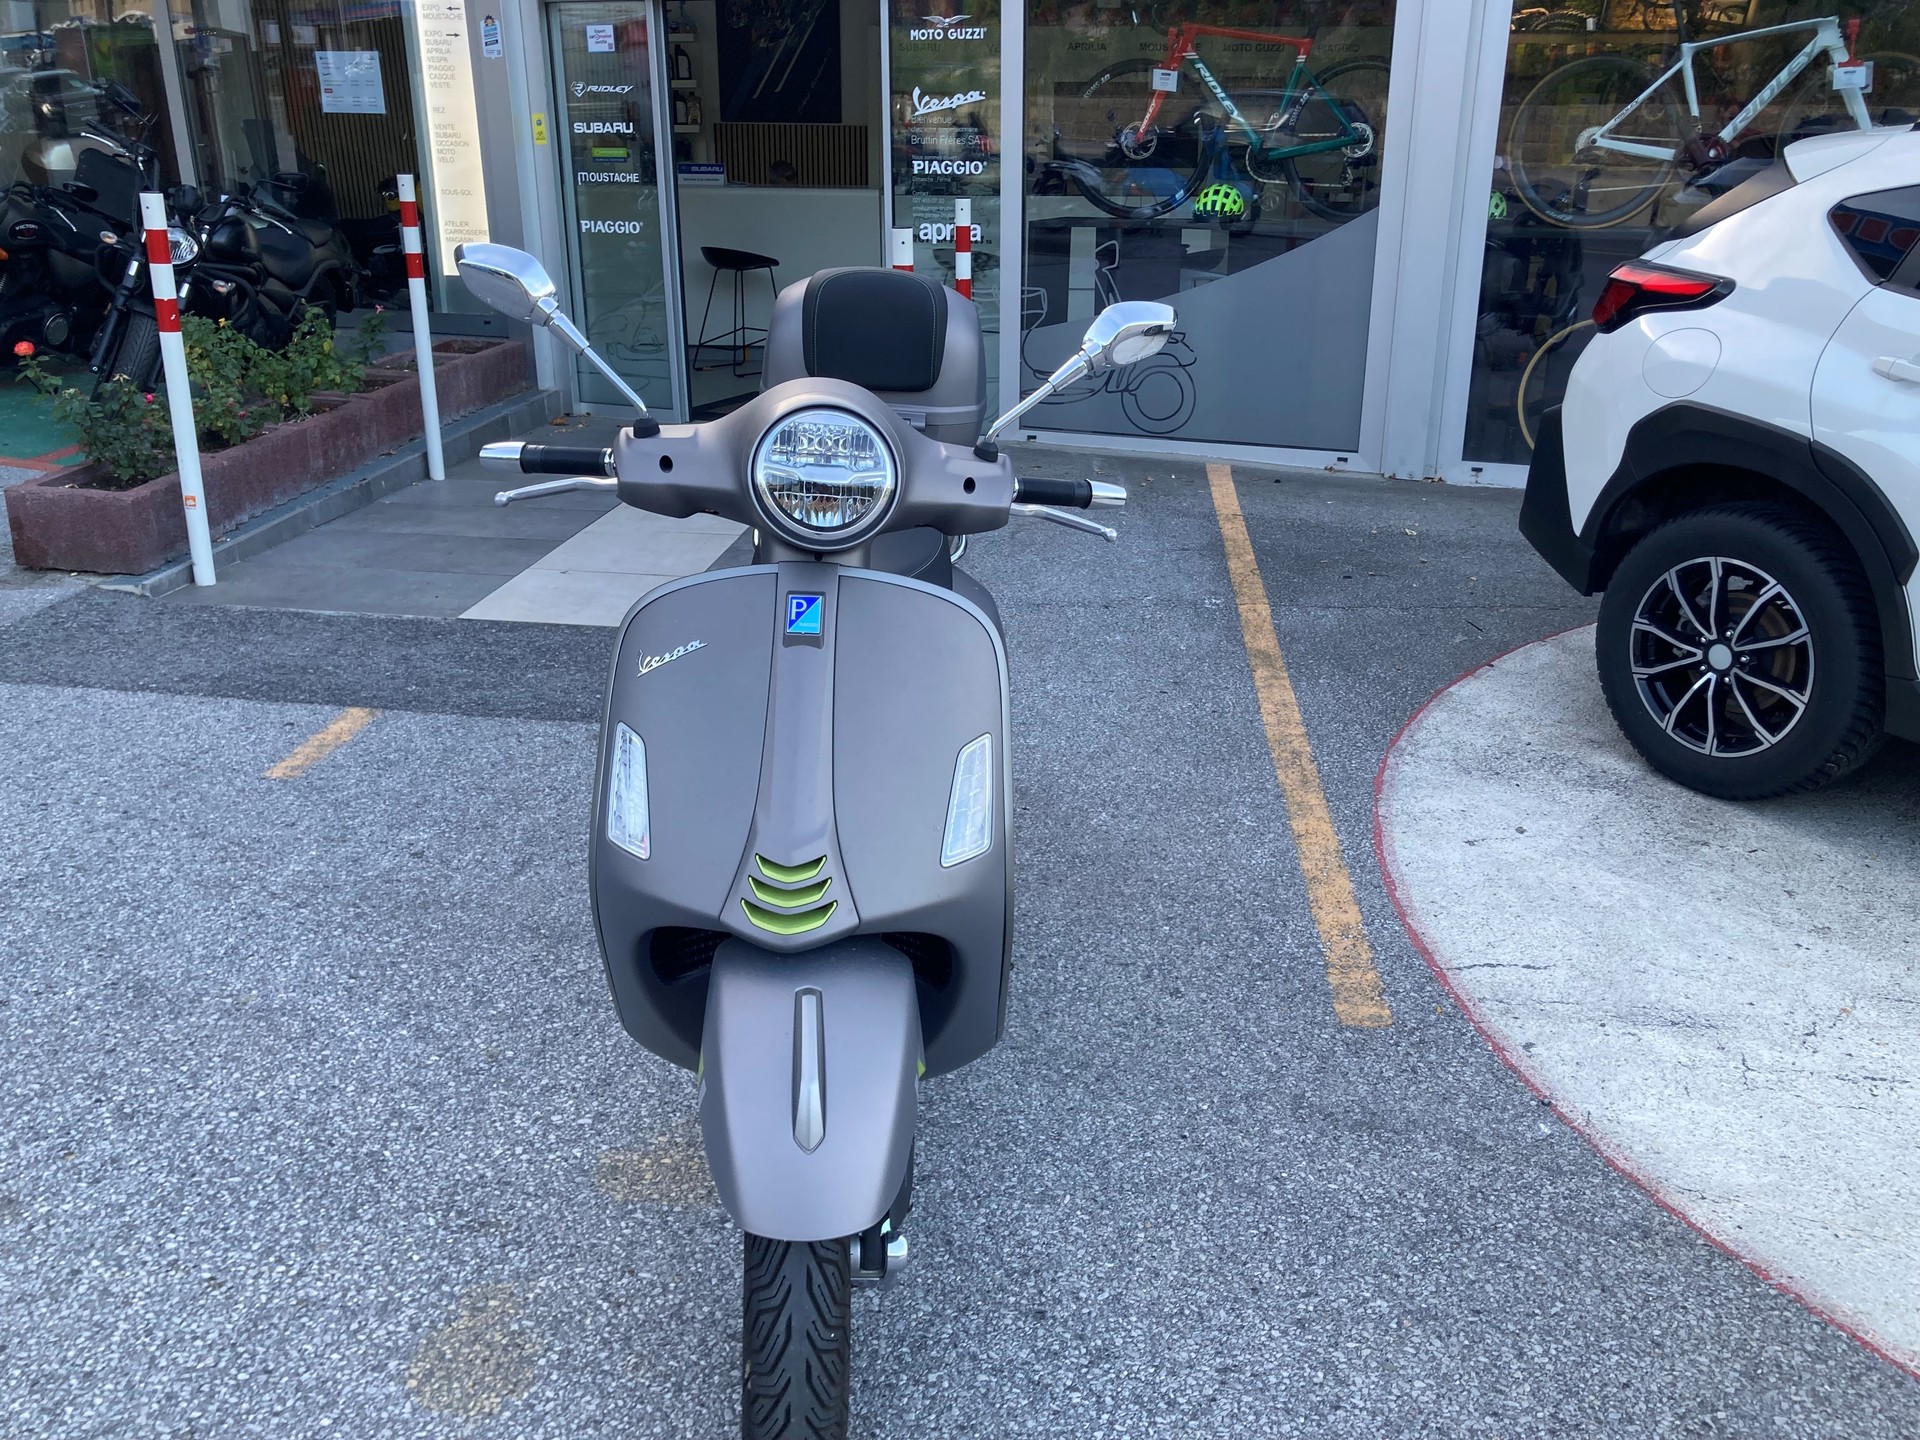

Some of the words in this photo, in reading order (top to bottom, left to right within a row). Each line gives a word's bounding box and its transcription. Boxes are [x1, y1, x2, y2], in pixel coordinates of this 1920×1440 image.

[421, 4, 440, 12] EXPO
[422, 13, 465, 21] MOUSTACHE
[424, 30, 443, 38] EXPO
[910, 29, 944, 40] MOTO
[947, 28, 984, 40] GUZZI
[426, 47, 451, 55] APRILIA
[1067, 42, 1107, 51] APRILIA
[1139, 42, 1202, 52] MOUSE
[1222, 43, 1252, 53] MOTO
[1254, 43, 1286, 52] GUZZI
[428, 64, 456, 72] PIAGGIO
[428, 73, 456, 81] CASQUE
[430, 81, 451, 89] VESTE
[587, 85, 634, 94] RIDLEY
[1731, 38, 1819, 134] RIDLEY
[1194, 62, 1246, 123] RIDLEY
[912, 86, 986, 116] Vespa
[911, 115, 952, 124] Bienvenue
[574, 121, 634, 134] SUBARU
[911, 134, 938, 145] Bruttin
[939, 134, 966, 145] Frères
[968, 134, 980, 145] SA
[690, 165, 723, 173] SUBARU
[911, 161, 984, 175] PIAGGIO
[578, 172, 640, 186] MOUSTACHE
[441, 188, 473, 196] SOUS-SOL
[445, 228, 489, 236] CARROSSERIE
[580, 220, 641, 234] PIAGGIO
[919, 221, 982, 244] apra
[790, 599, 808, 620] P
[636, 639, 709, 678] Vespa
